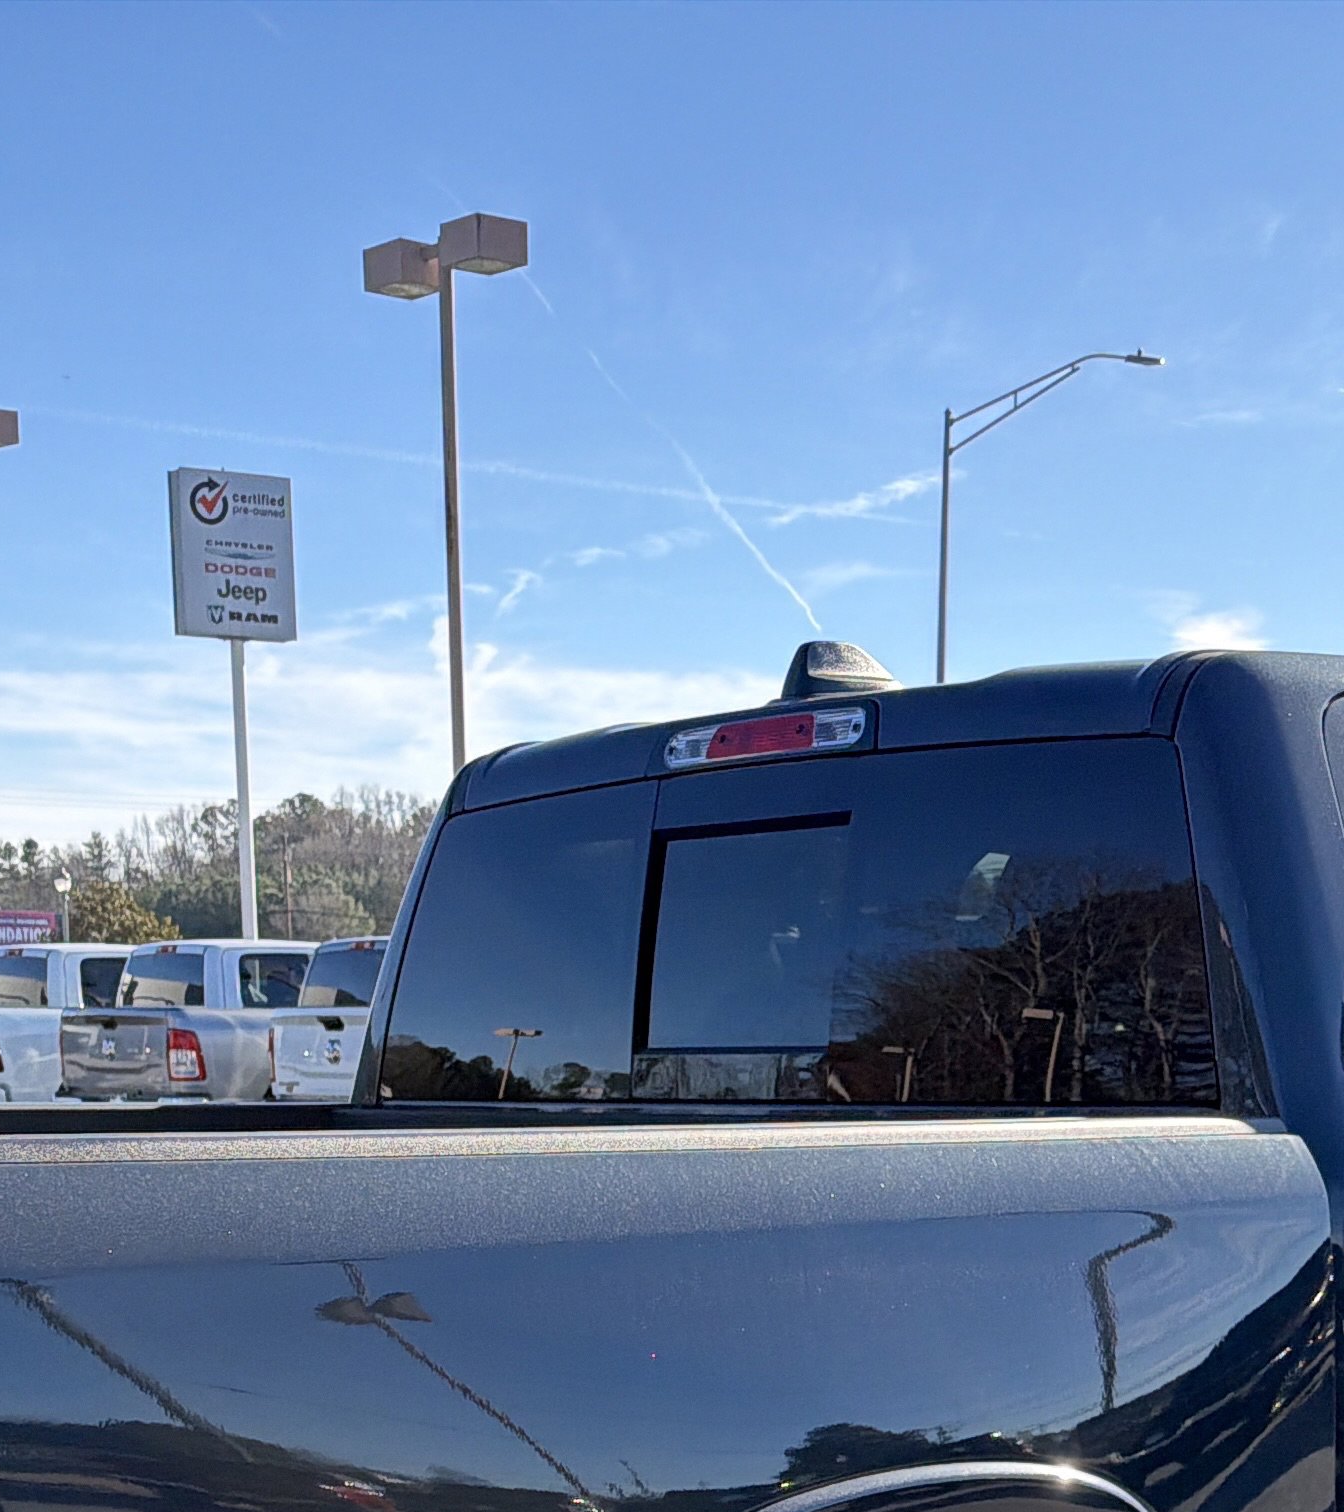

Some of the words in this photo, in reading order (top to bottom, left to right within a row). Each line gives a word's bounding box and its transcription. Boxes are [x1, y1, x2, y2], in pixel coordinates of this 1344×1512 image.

[232, 493, 285, 507] certified
[232, 506, 286, 518] pre-owned
[205, 540, 274, 551] CHRYSLER
[204, 562, 276, 578] DODGE
[217, 579, 267, 605] Jeep
[228, 611, 279, 624] RAM
